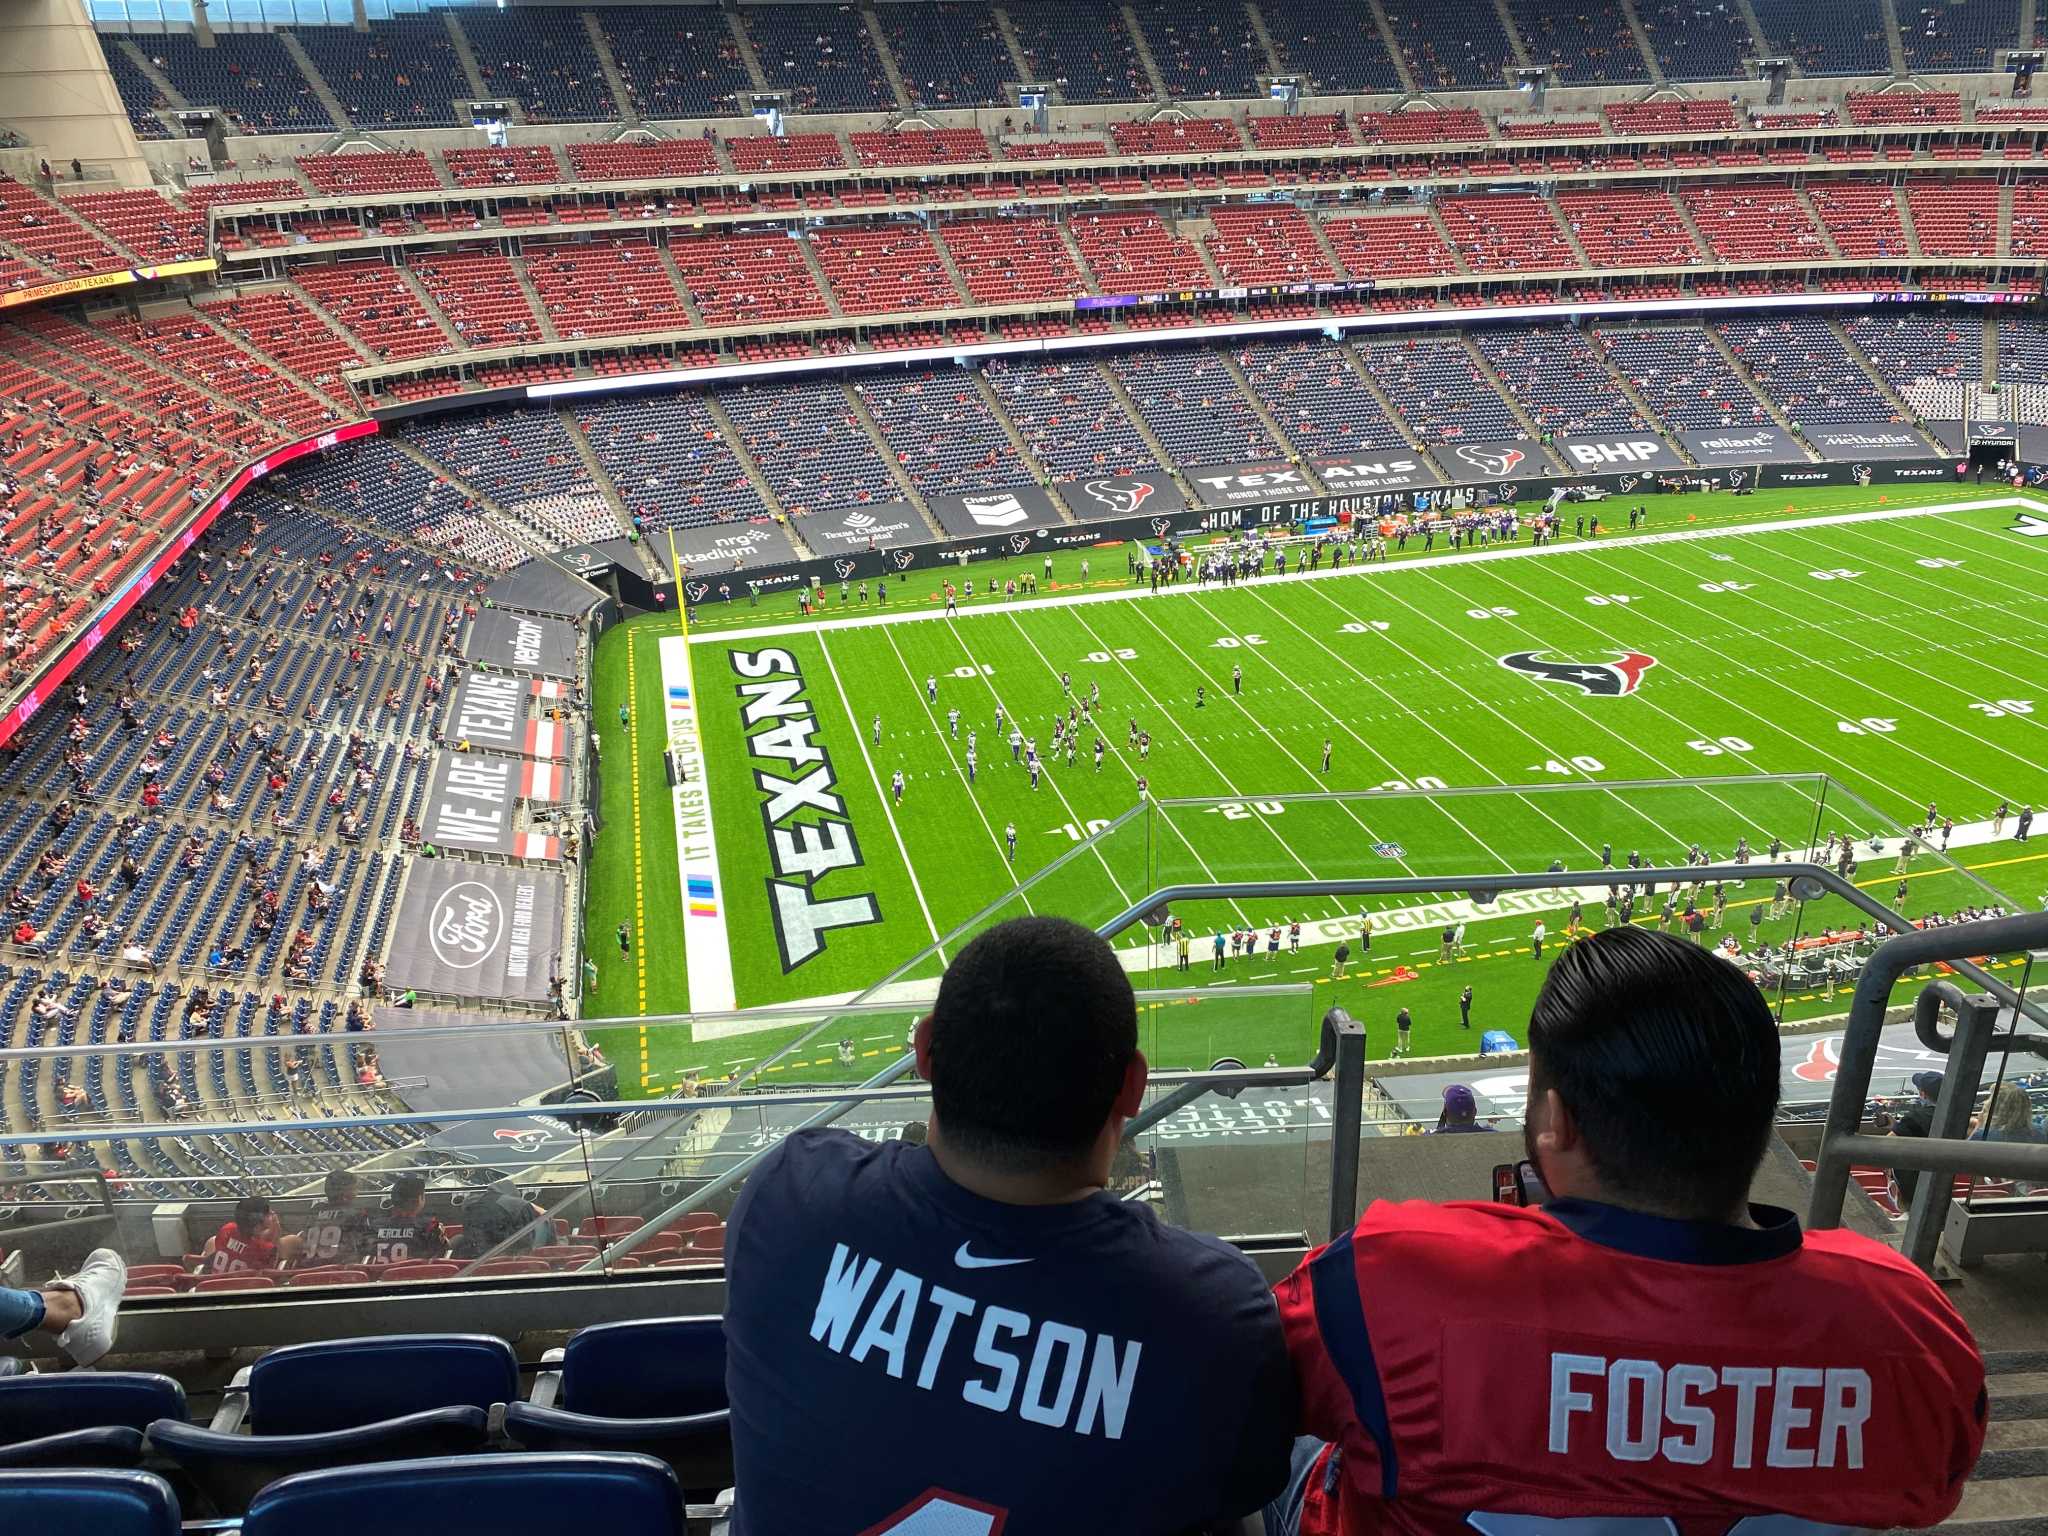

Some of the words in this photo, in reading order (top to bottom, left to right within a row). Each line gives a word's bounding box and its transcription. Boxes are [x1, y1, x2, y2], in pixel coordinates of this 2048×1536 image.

[1700, 436, 1764, 448] reliant
[1981, 439, 2014, 447] HYUNDAI
[1567, 441, 1660, 464] BHP
[1321, 460, 1417, 478] ANS
[1780, 472, 1829, 481] TEXANS
[1894, 468, 1943, 477] TEXANS
[1198, 471, 1302, 490] TEX
[1328, 481, 1348, 489] THE
[1349, 478, 1382, 488] FRONT
[1384, 476, 1410, 486] LINES
[962, 494, 1015, 505] Chevron
[1263, 486, 1293, 497] THOSE
[1209, 508, 1252, 529] HOM
[1261, 505, 1281, 523] OF
[1290, 502, 1320, 520] THE
[715, 535, 752, 546] nrg
[821, 530, 855, 539] Texas
[1053, 532, 1101, 544] TEXANS
[677, 545, 758, 565] stadium
[745, 574, 800, 588] TEXANS
[1465, 606, 1520, 619] 50
[508, 618, 543, 666] verizon
[1087, 648, 1139, 663] 20
[954, 663, 997, 678] 10
[456, 673, 520, 741] TEXANS
[1967, 699, 2034, 718] 30
[1837, 717, 1897, 736] 40
[1686, 736, 1755, 756] 50
[1544, 755, 1606, 776] 40
[445, 757, 508, 803] ARE
[679, 789, 707, 839] TAKES
[728, 647, 884, 975] TEXANS
[1218, 801, 1286, 821] 20
[434, 803, 502, 843] WE
[684, 845, 711, 861] IT
[437, 894, 494, 953] Ford
[1317, 905, 1470, 939] CRUCIAL
[226, 1238, 249, 1254] WATT
[809, 1242, 1142, 1440] WATSON
[1548, 1353, 1873, 1470] FOSTER
